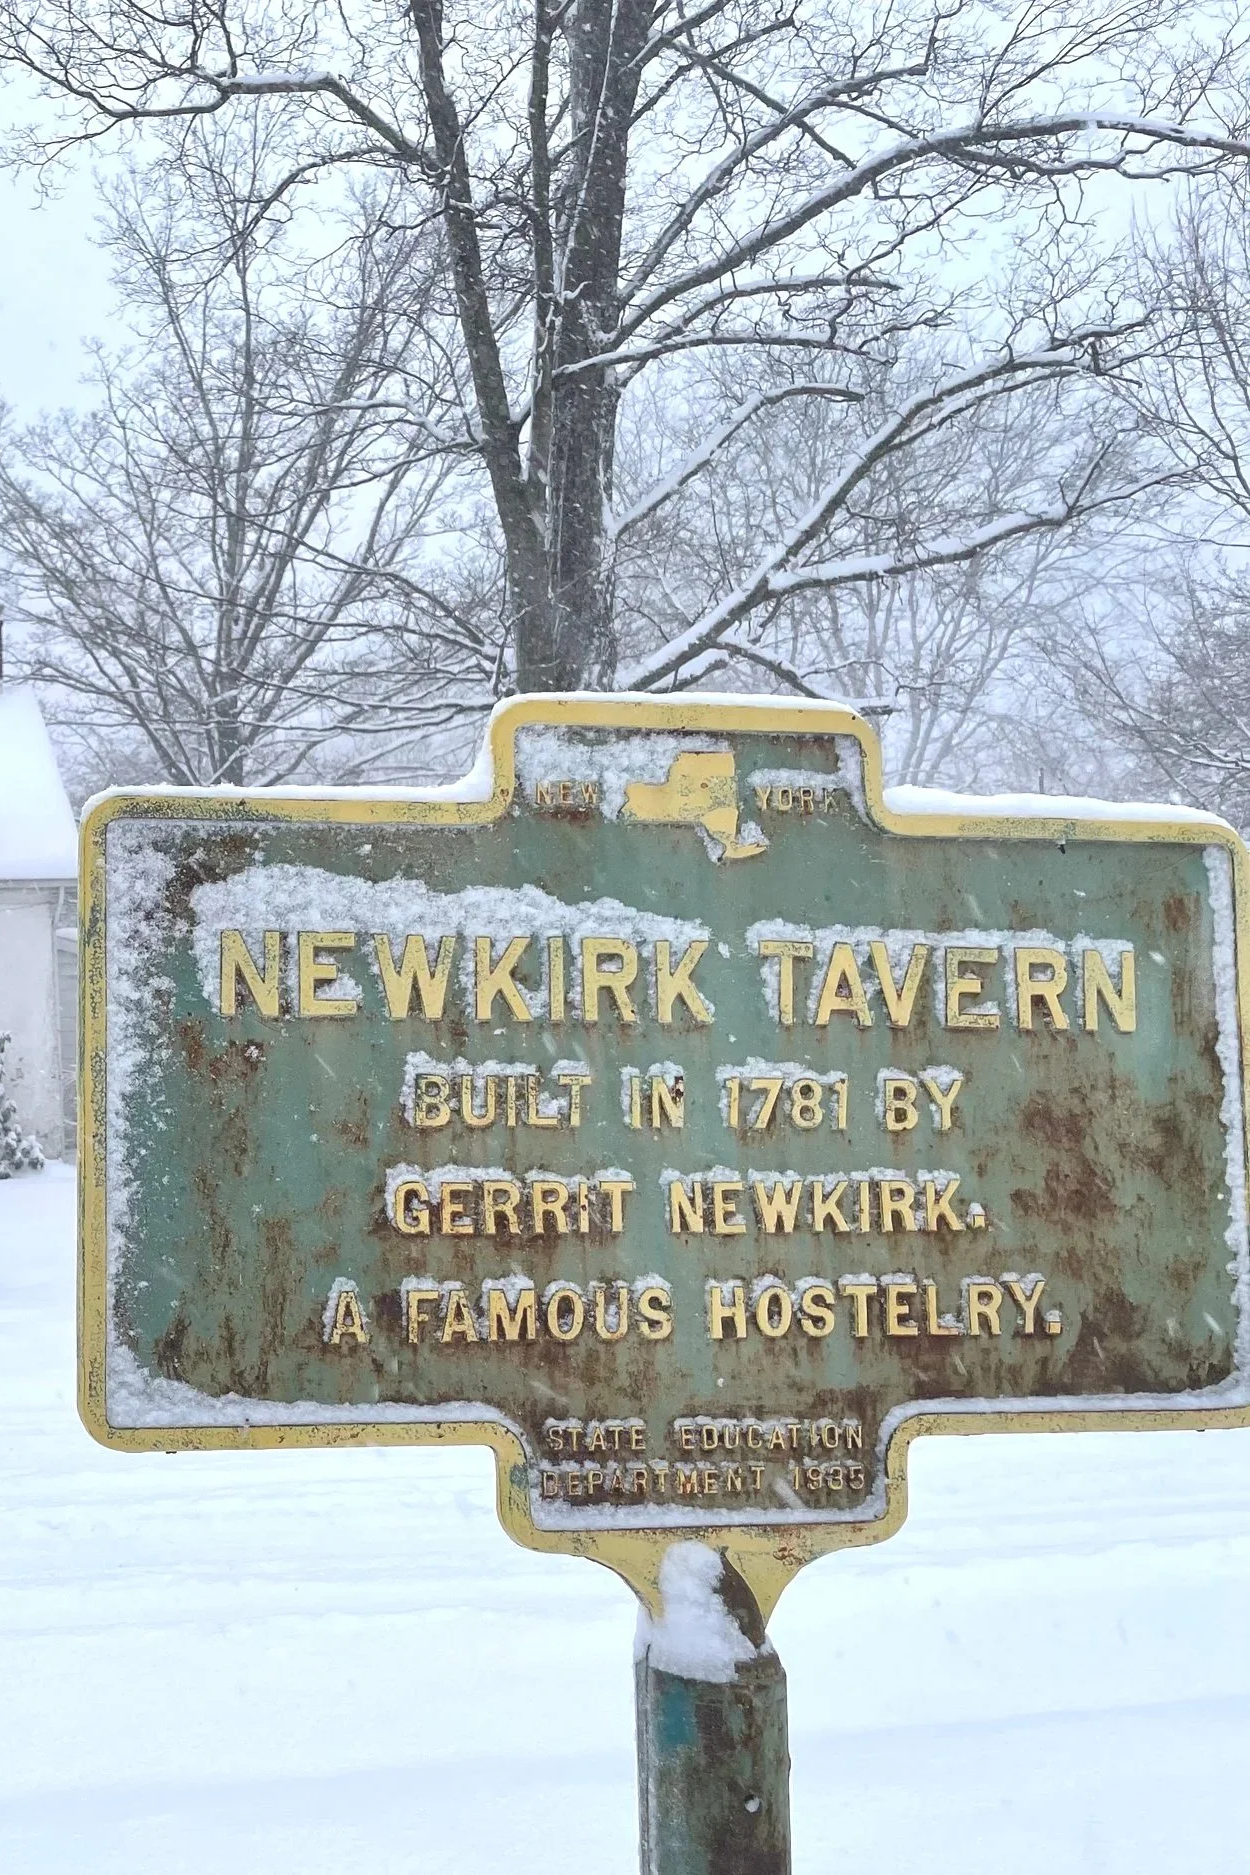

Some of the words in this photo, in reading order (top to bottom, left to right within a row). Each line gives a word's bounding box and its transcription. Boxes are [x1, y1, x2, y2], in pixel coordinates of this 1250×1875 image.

[534, 783, 600, 804] NEW
[755, 786, 837, 812] YORK
[219, 930, 714, 1023] NEWKIRK
[758, 940, 1137, 1033] TAVERN
[415, 1074, 592, 1127] BUILT
[631, 1075, 685, 1128] IN
[725, 1077, 848, 1131] 1781
[885, 1079, 962, 1132] BY
[393, 1180, 634, 1235] GERRIT
[669, 1177, 986, 1234] NEWKIRK.
[331, 1290, 368, 1345] A
[407, 1286, 674, 1344] FAMOUS
[709, 1280, 1062, 1340] HOSTELRY.
[550, 1426, 646, 1452] STATE
[680, 1423, 863, 1450] EDUCATION
[542, 1466, 765, 1497] DEPARTMENT
[791, 1465, 865, 1490] 1935
